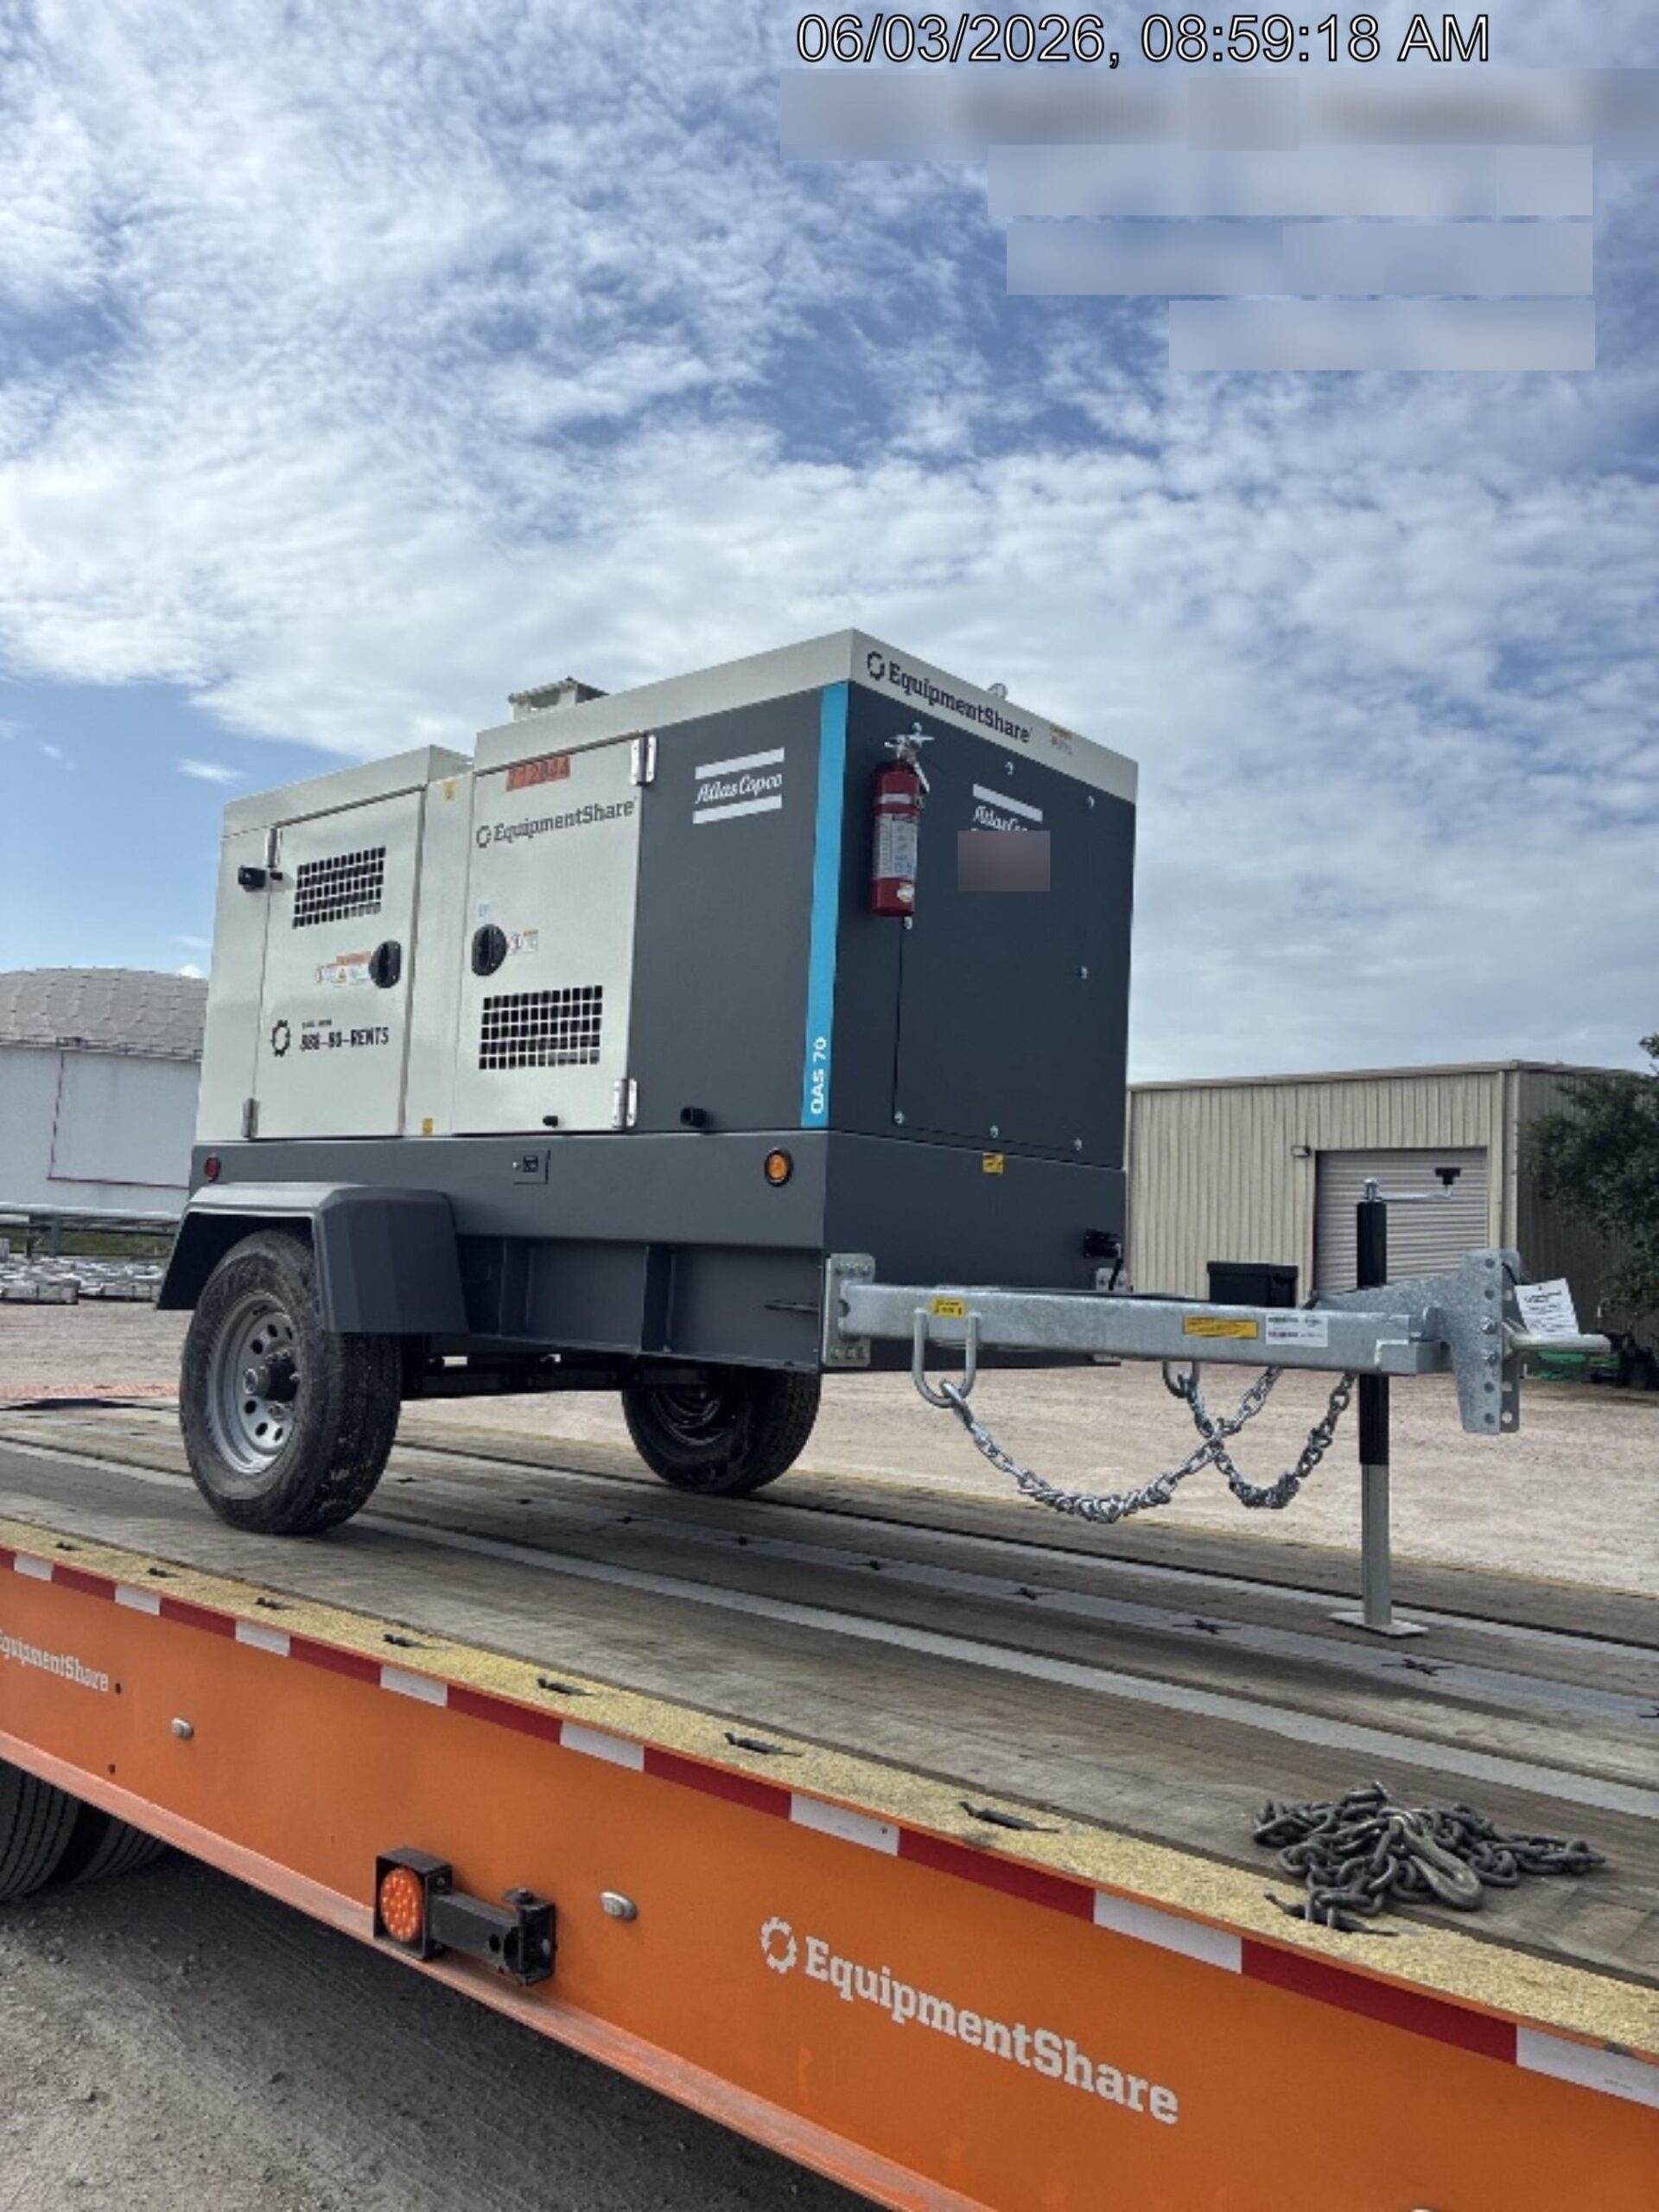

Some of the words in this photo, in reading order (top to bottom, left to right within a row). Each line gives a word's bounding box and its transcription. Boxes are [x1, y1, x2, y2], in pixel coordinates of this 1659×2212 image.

[889, 660, 1033, 743] EquipmentShare
[493, 800, 635, 843] EquipmentShare
[813, 1036, 827, 1064] 70
[810, 1068, 824, 1115] QAS
[804, 1936, 1179, 2125] EquipmentShare
